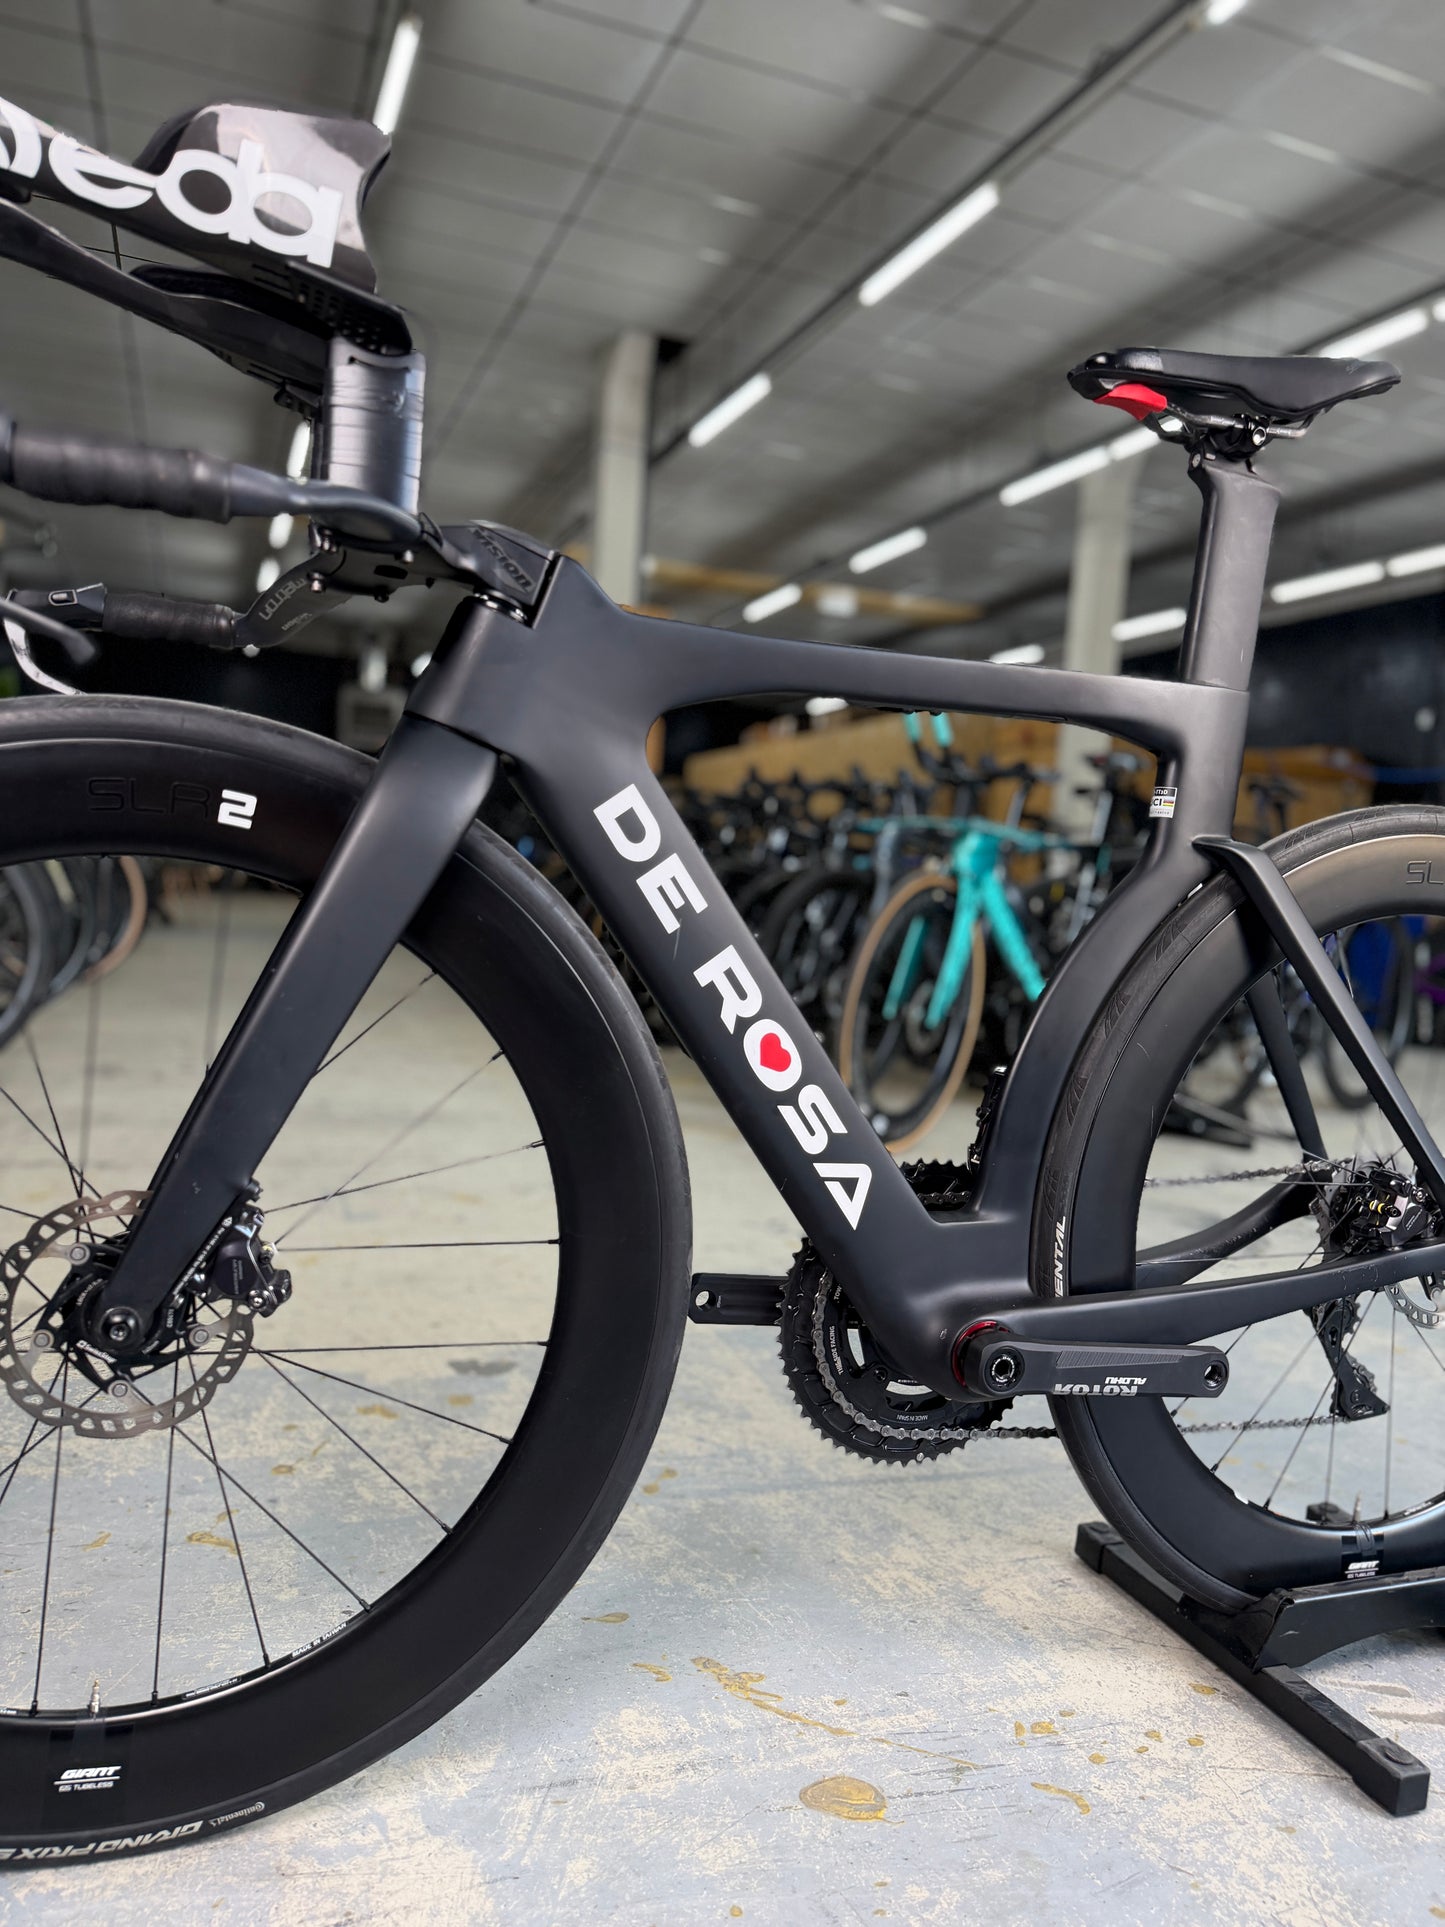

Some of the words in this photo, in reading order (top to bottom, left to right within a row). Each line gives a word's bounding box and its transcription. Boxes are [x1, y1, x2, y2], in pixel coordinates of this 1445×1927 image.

[593, 783, 708, 934] DE
[693, 944, 875, 1230] ROSA
[1054, 1215, 1066, 1297] ENTAL
[1104, 1376, 1147, 1385] ALDHU
[1052, 1383, 1138, 1396] ROTOR
[1348, 1560, 1380, 1570] GIANT
[291, 1642, 312, 1658] MADE
[313, 1637, 321, 1646] IN
[322, 1622, 347, 1641] TAIWAN
[60, 1765, 122, 1780] GIANT
[73, 1781, 114, 1791] TUBELESS
[215, 1801, 266, 1827] Continental
[94, 1820, 204, 1854] GRAND
[13, 1843, 95, 1860] PRIX
